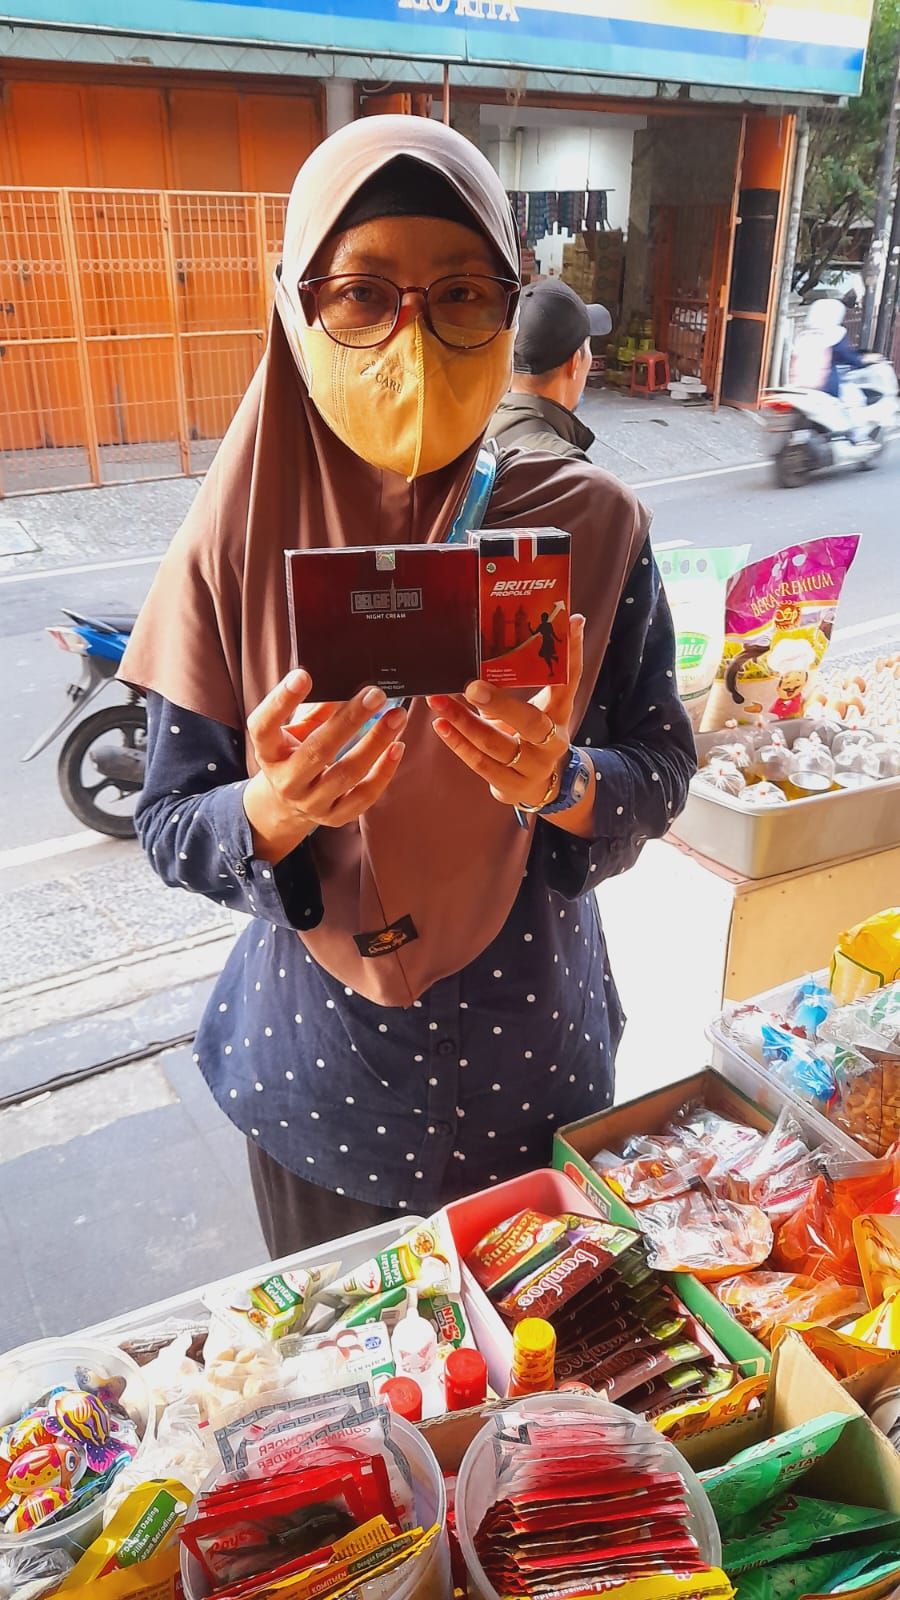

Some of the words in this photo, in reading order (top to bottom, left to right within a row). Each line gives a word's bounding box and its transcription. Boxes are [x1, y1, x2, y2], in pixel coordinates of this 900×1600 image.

[492, 579, 557, 591] BRITISH
[780, 572, 834, 597] REMIUM
[354, 592, 391, 610] BELGIE
[396, 591, 419, 608] PRO
[517, 1247, 600, 1308] bamboe
[140, 1507, 160, 1530] Daging
[151, 1511, 176, 1544] Beriodium
[131, 1534, 151, 1557] Pilihan
